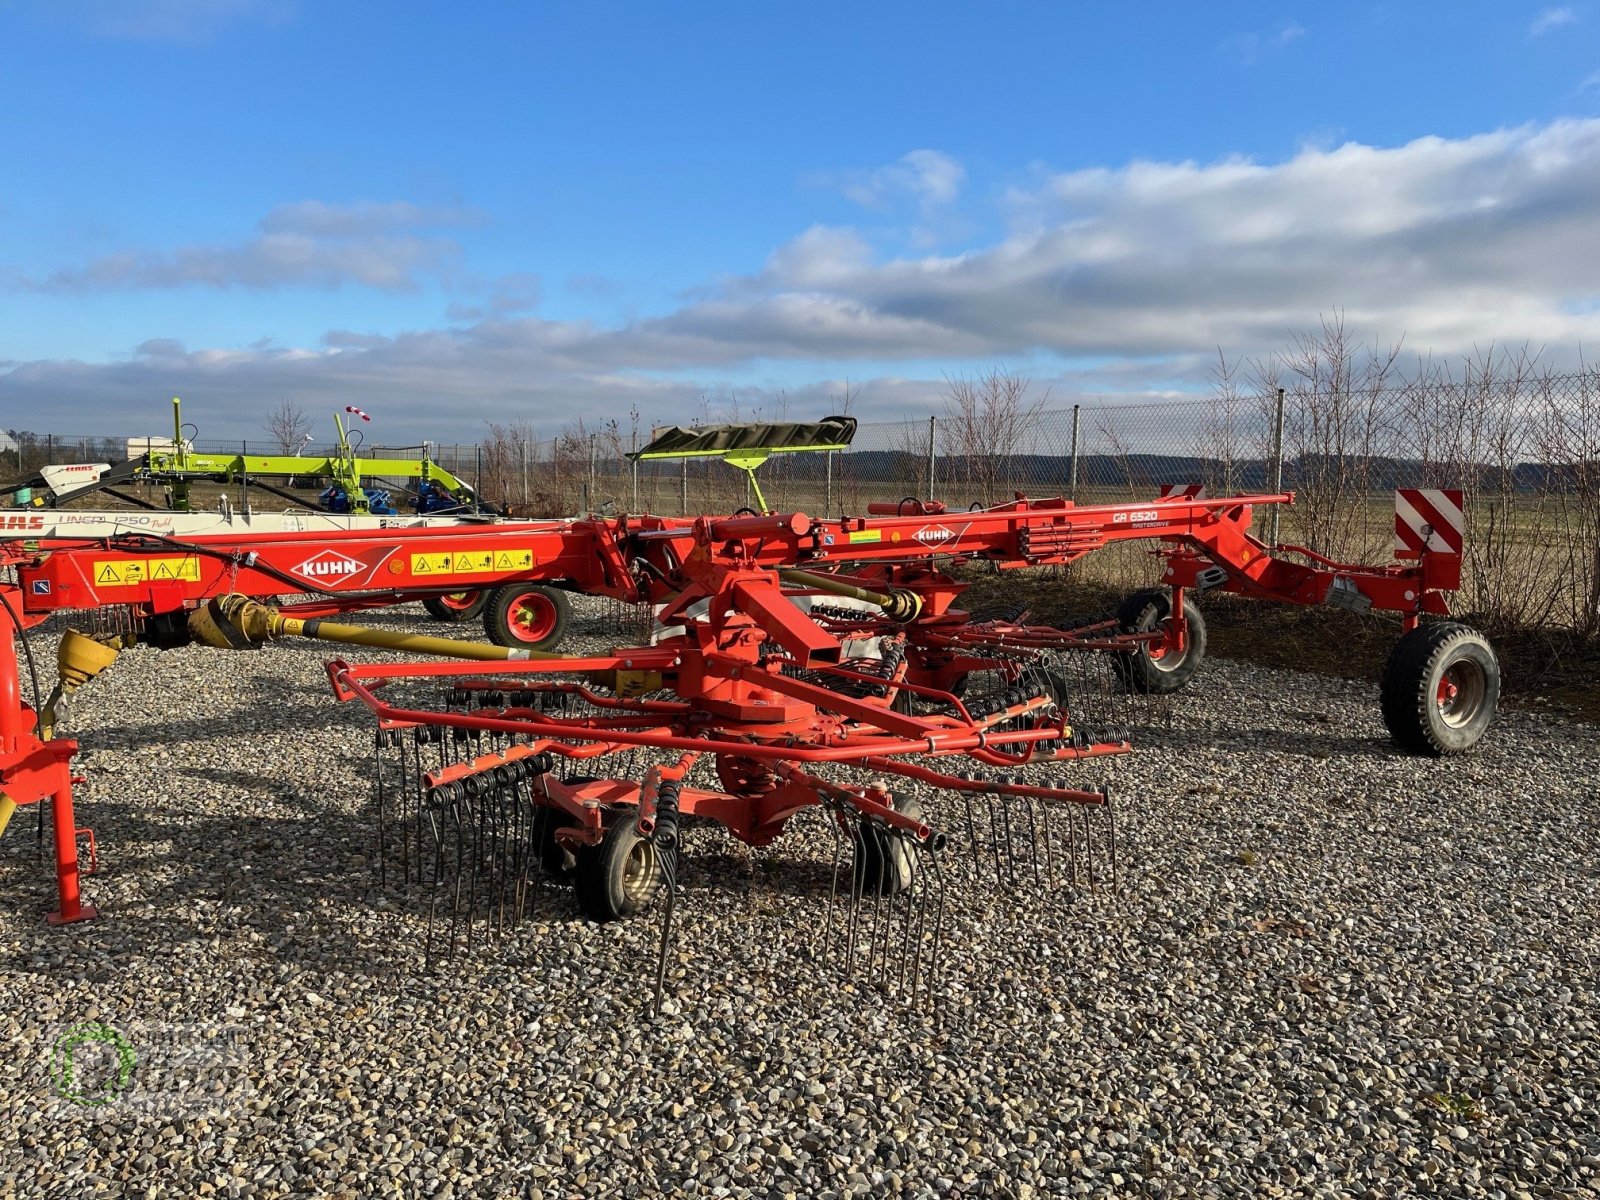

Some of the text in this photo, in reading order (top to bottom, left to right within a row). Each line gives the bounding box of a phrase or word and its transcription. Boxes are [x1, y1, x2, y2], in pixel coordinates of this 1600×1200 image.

[114, 516, 150, 525] 1250
[1113, 511, 1158, 523] GA 6520
[1132, 521, 1169, 529] MASTERDRIVE
[918, 530, 949, 541] KUHN
[302, 560, 357, 576] KUHN
